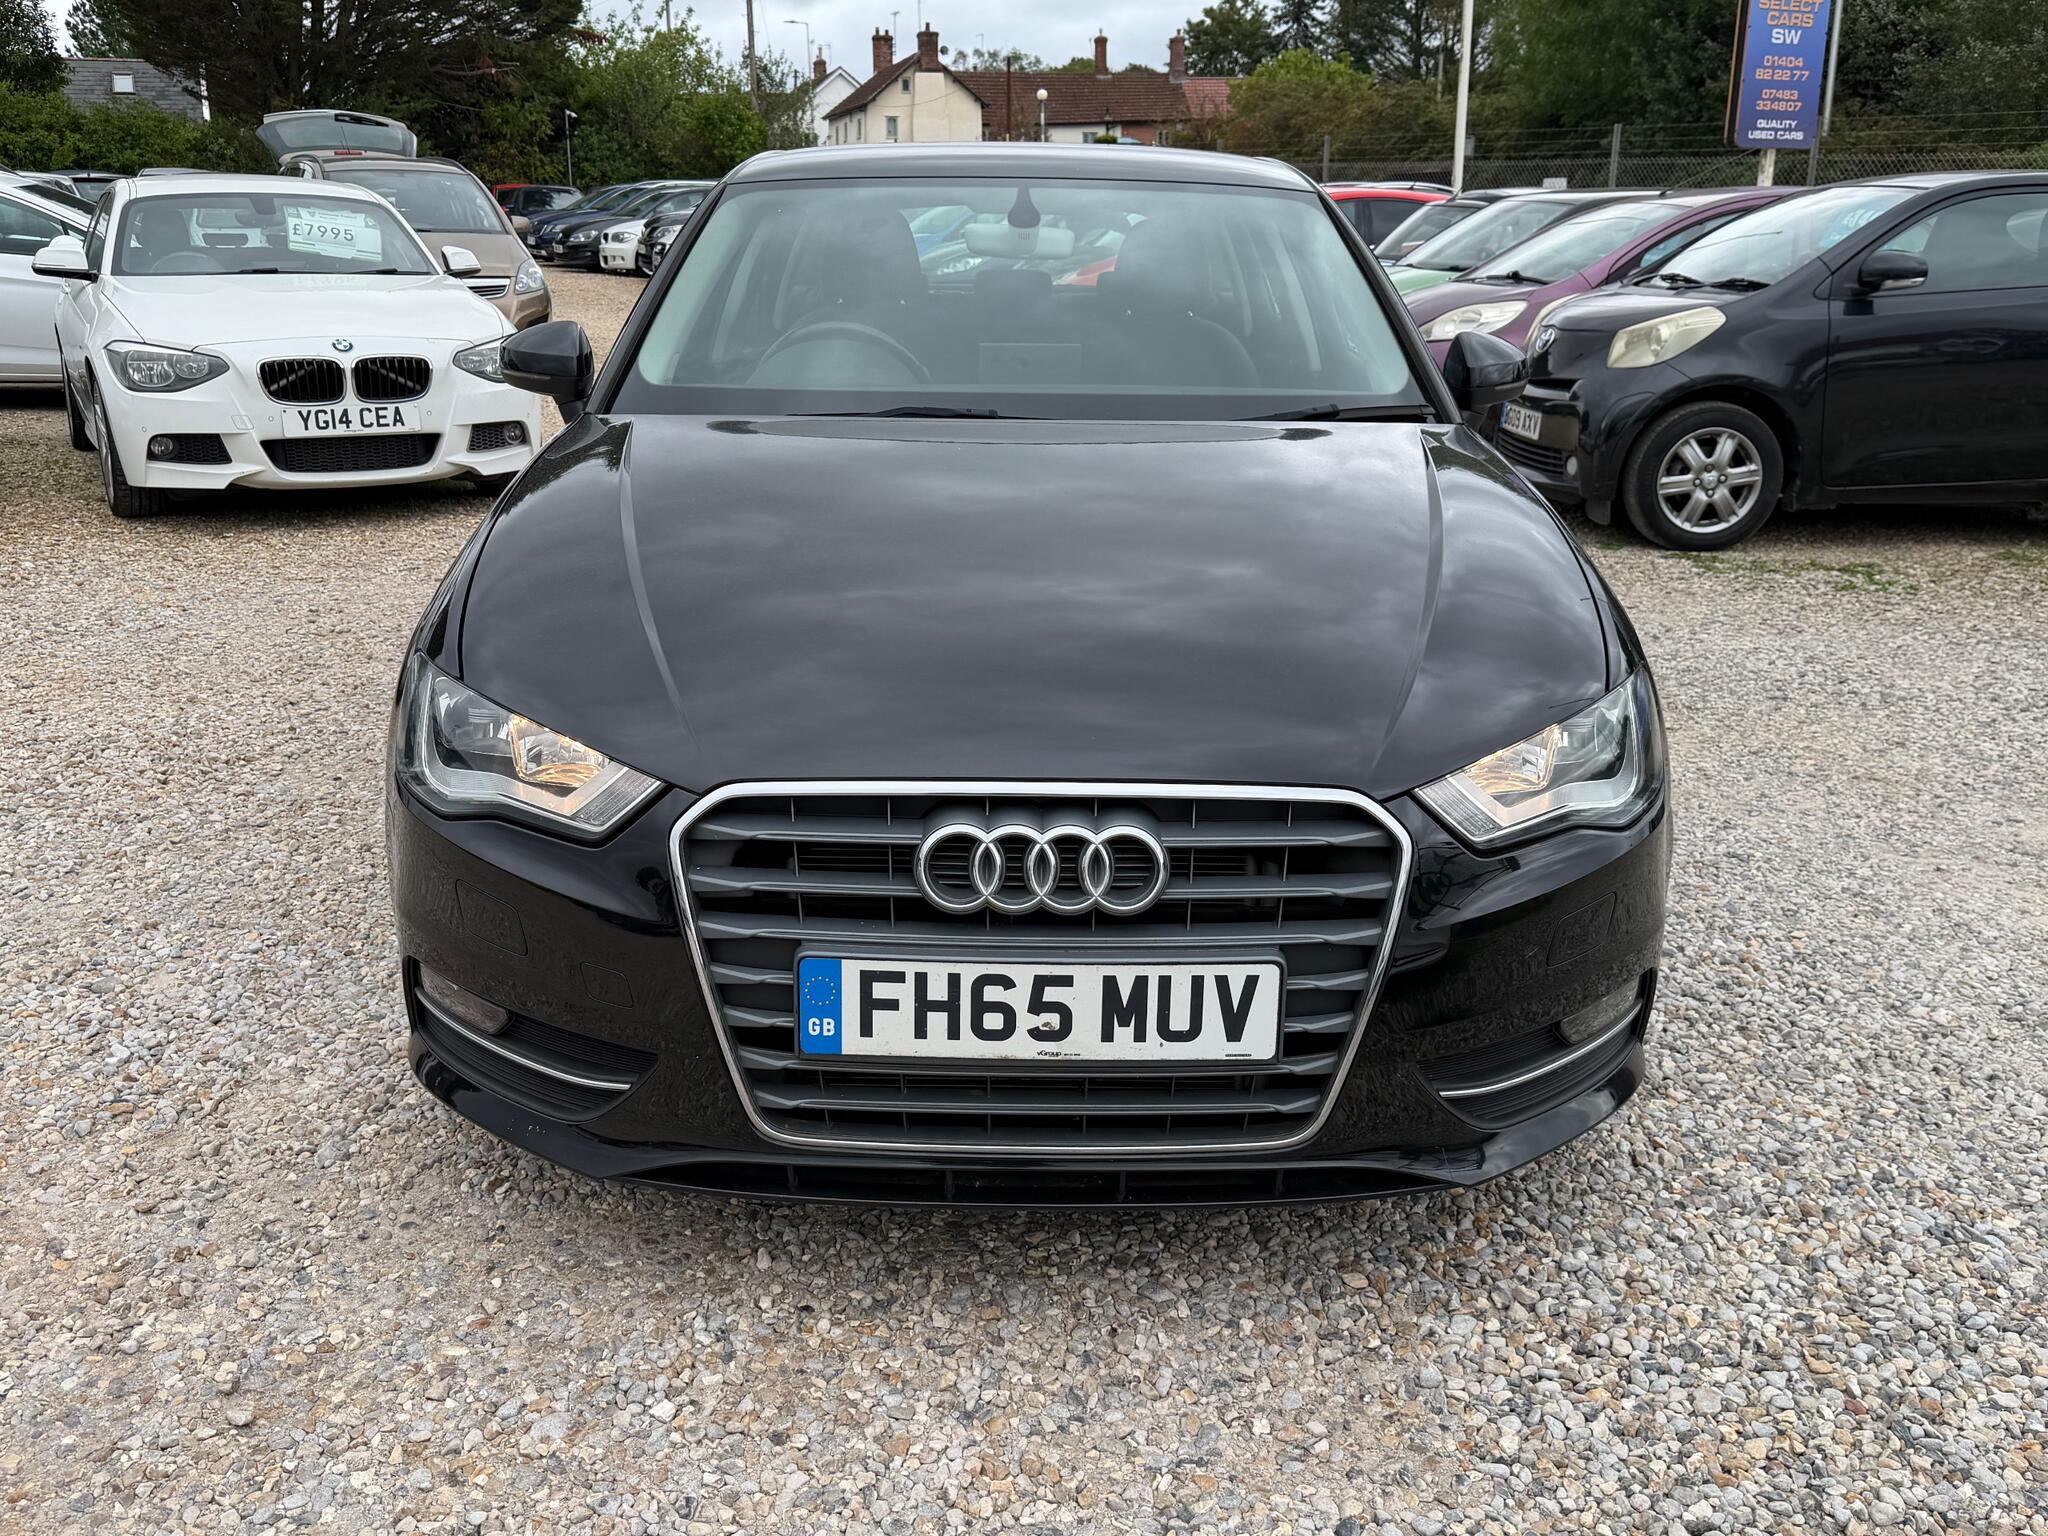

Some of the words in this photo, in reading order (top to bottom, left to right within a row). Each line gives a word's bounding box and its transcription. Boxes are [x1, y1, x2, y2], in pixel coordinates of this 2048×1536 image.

[1759, 0, 1822, 12] SELECT
[1767, 12, 1814, 27] CARS
[1771, 29, 1801, 44] SW
[1764, 55, 1803, 67] 01404
[1762, 89, 1798, 100] 07483
[1756, 100, 1802, 111] 334807
[1757, 119, 1797, 129] QUALITY
[1748, 130, 1774, 139] USED
[1776, 130, 1804, 140] CARS
[293, 223, 354, 241] £7995
[297, 408, 352, 431] YG14
[359, 406, 405, 428] CEA
[859, 969, 1074, 1042] FH65
[1100, 974, 1260, 1043] MUV
[808, 1017, 835, 1036] GB
